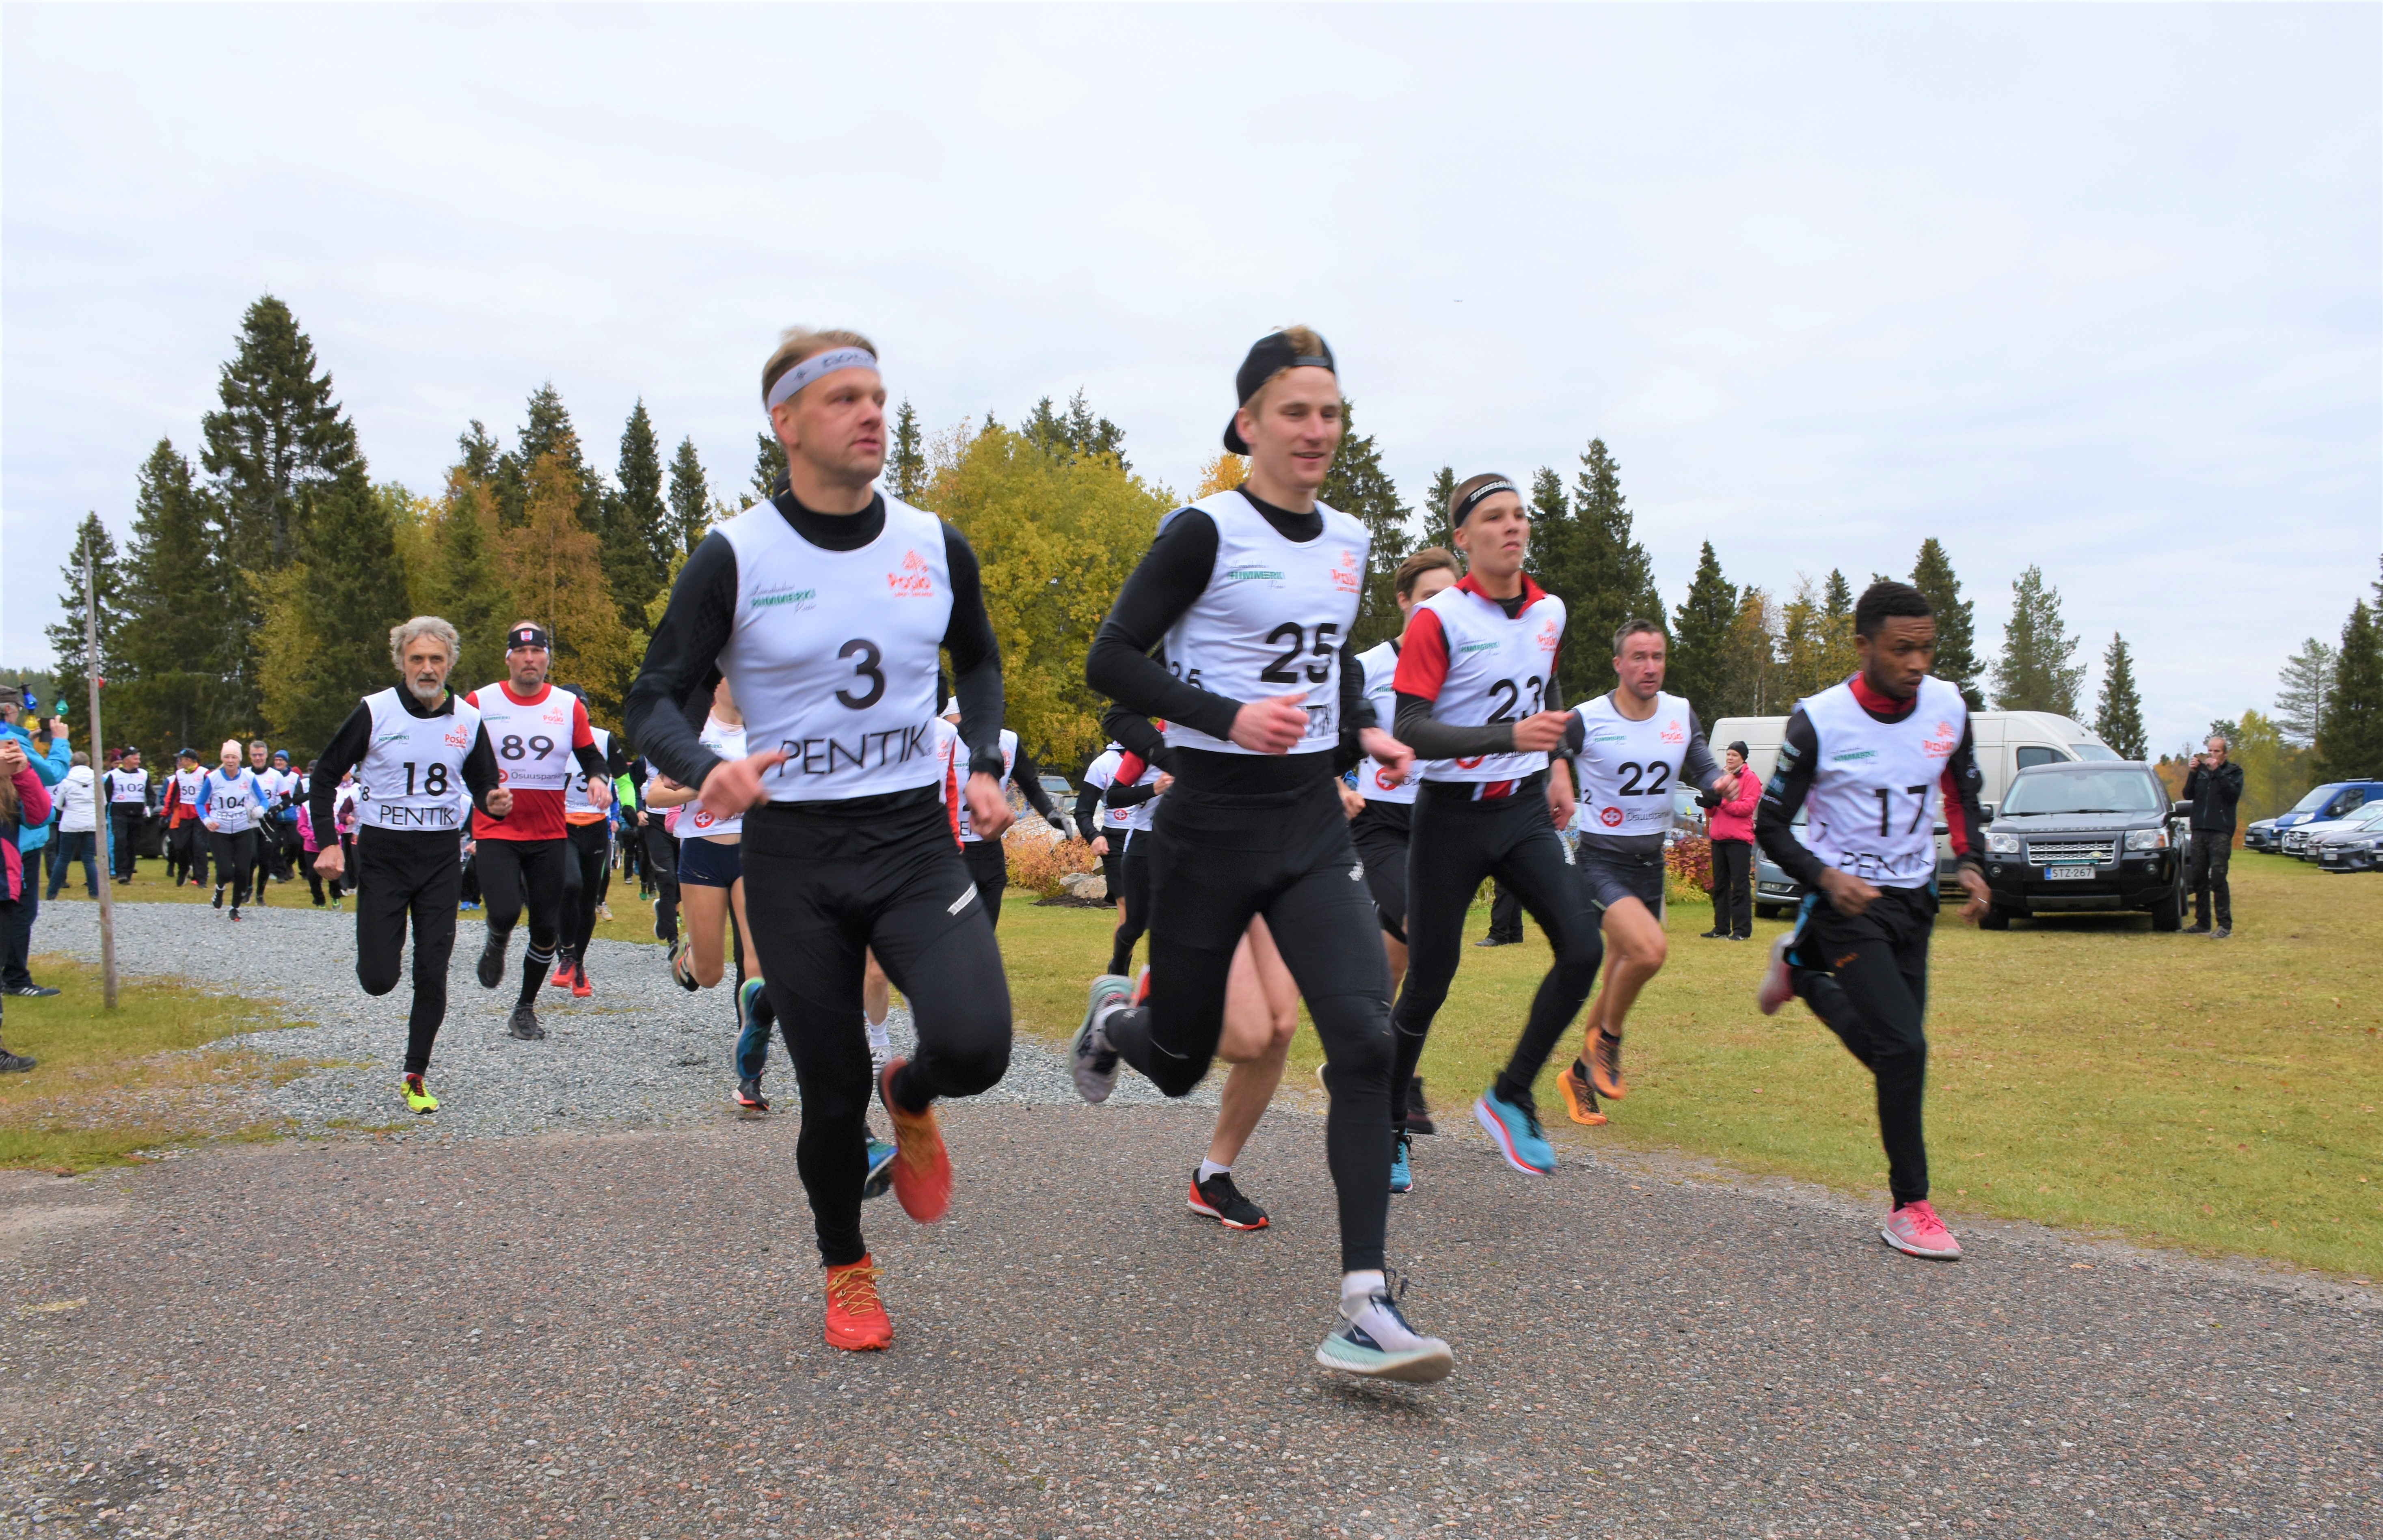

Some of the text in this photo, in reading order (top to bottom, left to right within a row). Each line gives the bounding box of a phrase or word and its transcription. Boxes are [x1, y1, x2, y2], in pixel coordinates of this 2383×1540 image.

[1261, 622, 1340, 684] 25
[836, 638, 885, 710] 3
[1487, 676, 1541, 723] 23
[501, 735, 554, 760] 89
[779, 720, 929, 777] PENTIK
[119, 783, 145, 792] 102
[182, 786, 195, 795] 50
[403, 762, 447, 796] 18
[1618, 761, 1670, 796] 22
[219, 796, 244, 809] 104
[380, 805, 454, 826] PENTIK
[1875, 785, 1927, 837] 17
[2053, 868, 2091, 878] STZ-267
